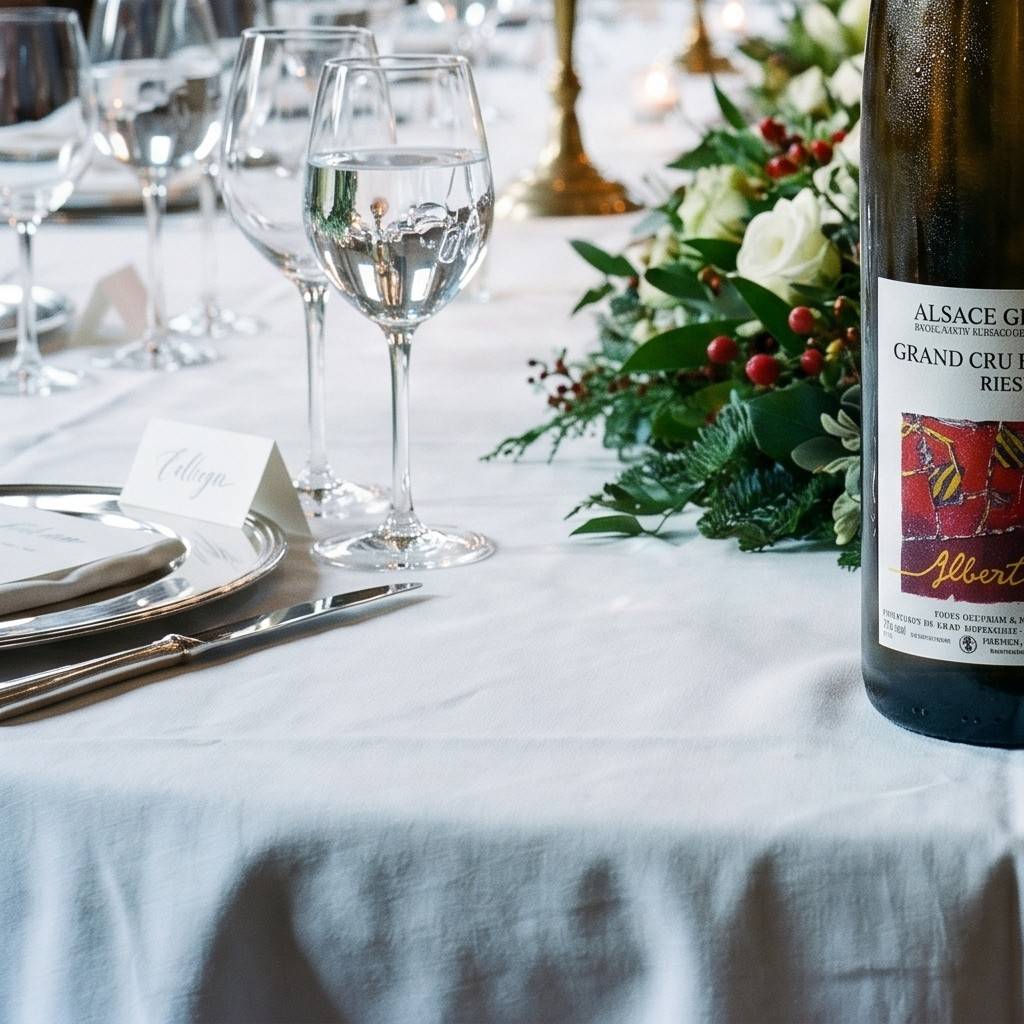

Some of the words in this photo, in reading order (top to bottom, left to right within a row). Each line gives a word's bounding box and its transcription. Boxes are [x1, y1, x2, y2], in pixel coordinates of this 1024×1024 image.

[914, 303, 997, 325] ALSACE
[893, 342, 963, 367] GRAND
[969, 352, 1013, 370] CRU
